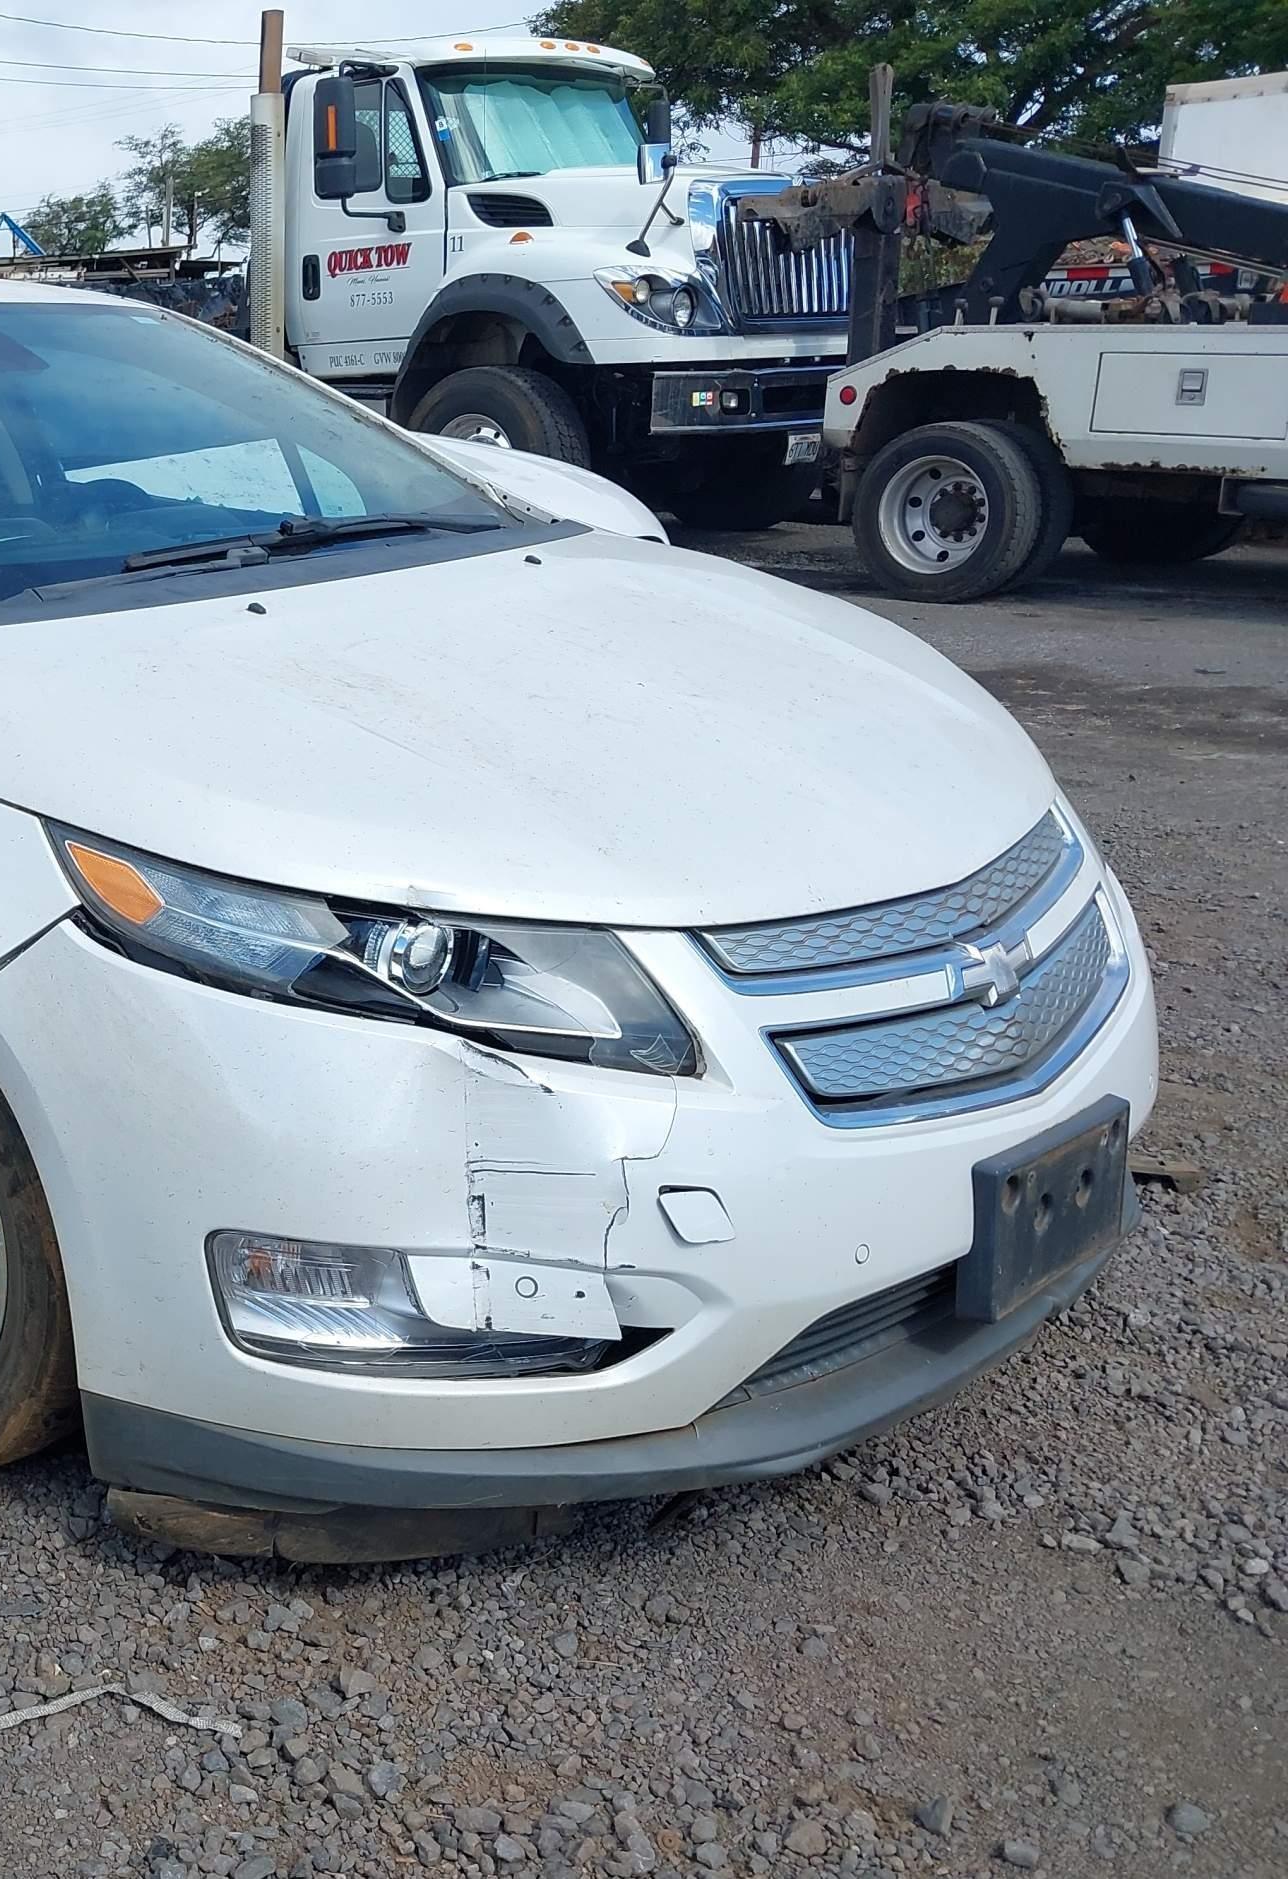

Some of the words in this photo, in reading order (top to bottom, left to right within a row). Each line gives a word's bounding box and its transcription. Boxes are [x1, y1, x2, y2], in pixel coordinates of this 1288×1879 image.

[450, 235, 464, 252] 11
[327, 246, 374, 278] QUICK
[375, 242, 412, 268] TOW
[350, 291, 394, 307] 877-5553
[374, 352, 392, 365] GVW
